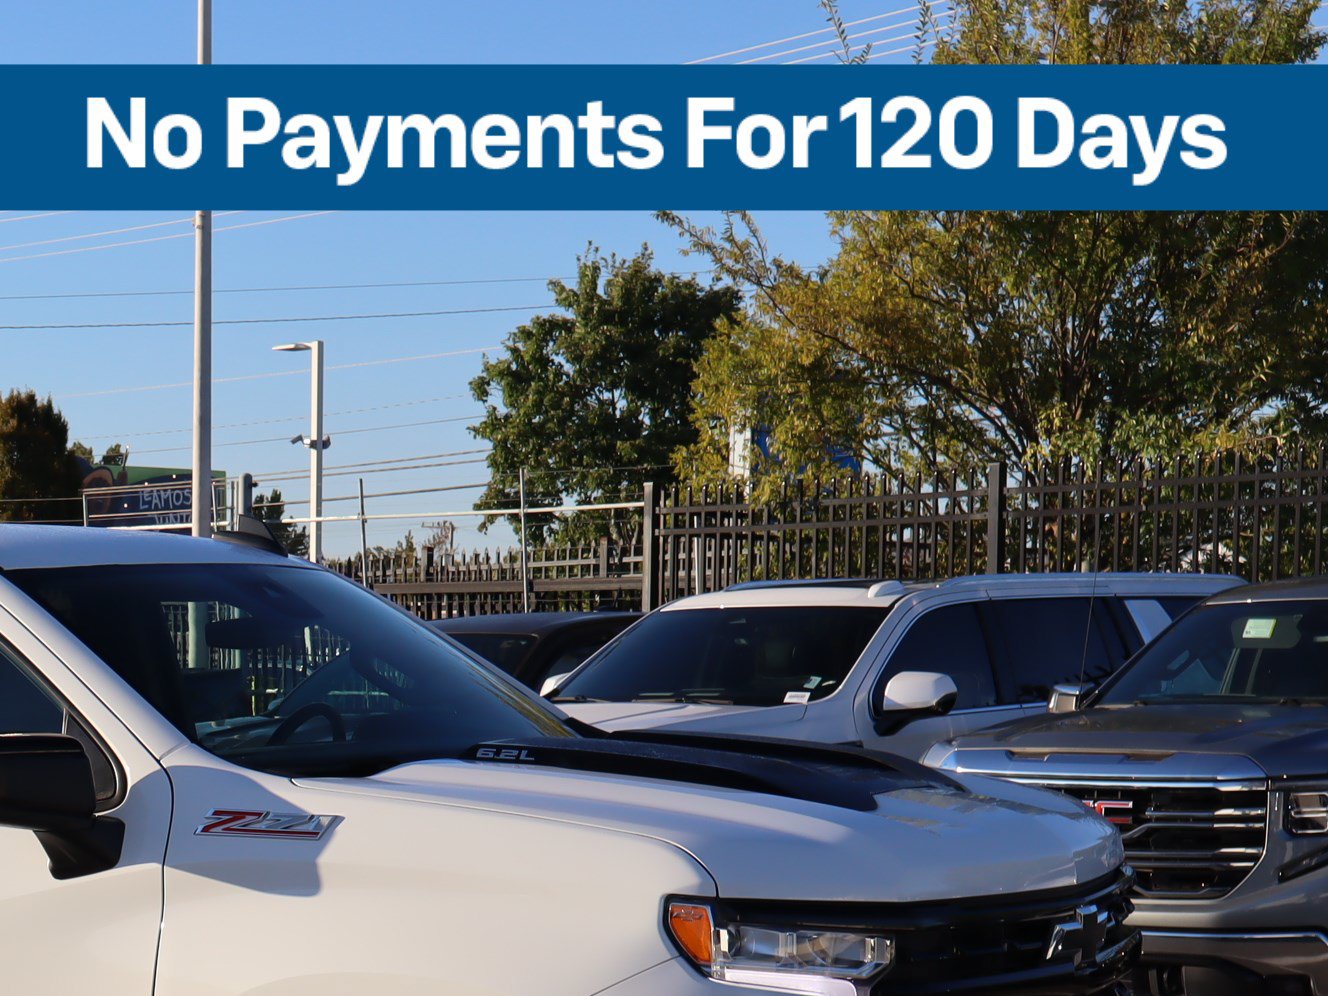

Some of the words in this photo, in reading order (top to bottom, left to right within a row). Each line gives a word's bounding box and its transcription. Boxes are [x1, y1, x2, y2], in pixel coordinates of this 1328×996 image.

[139, 488, 193, 511] LEAMOS
[476, 748, 535, 761] 6.2L
[193, 806, 346, 841] Z71
